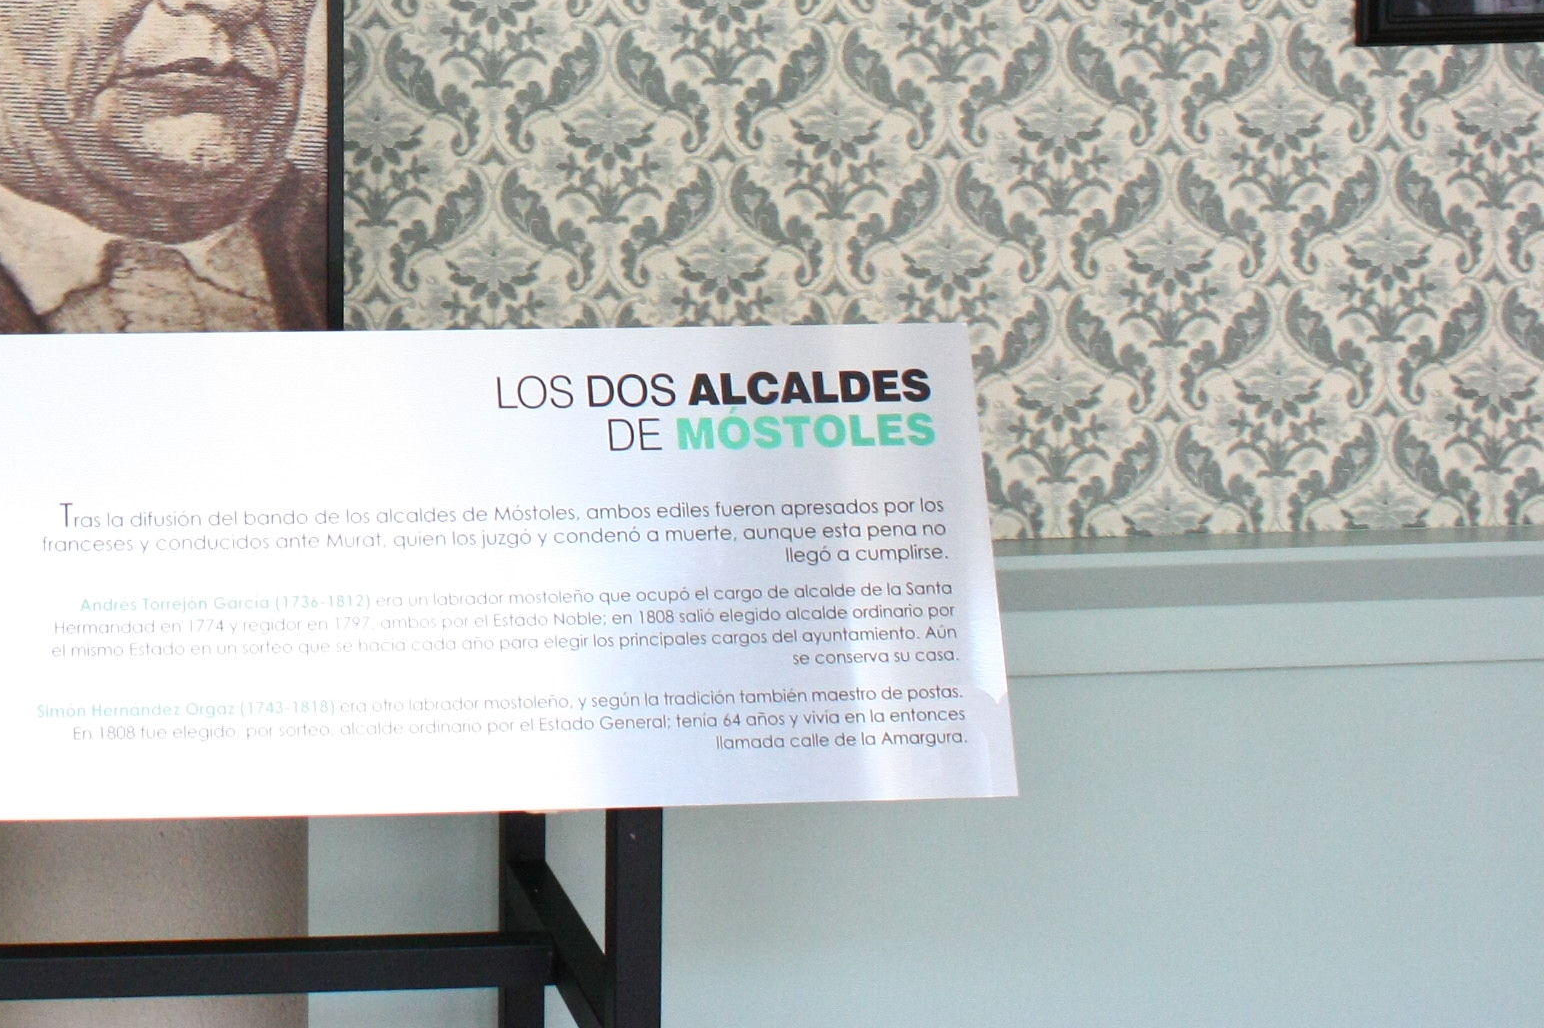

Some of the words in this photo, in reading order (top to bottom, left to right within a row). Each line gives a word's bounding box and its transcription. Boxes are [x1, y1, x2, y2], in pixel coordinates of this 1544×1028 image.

[496, 375, 573, 408] LOS
[587, 373, 675, 407] DOS
[688, 370, 930, 405] ALCALDES
[608, 418, 662, 451] DE
[677, 407, 936, 449] MÓSTOLES
[60, 503, 100, 527] Tras
[107, 513, 122, 527] la
[130, 512, 200, 526] difusión
[208, 511, 236, 525] del
[244, 510, 307, 525] bando
[315, 510, 338, 524] de
[346, 509, 369, 523] los
[376, 508, 456, 523] alcaldes
[462, 507, 487, 521] de
[494, 505, 579, 520] Móstoles,
[586, 504, 650, 519] ambos
[656, 502, 709, 518] ediles
[715, 502, 774, 516] fueron
[781, 500, 878, 518] apresados
[884, 501, 914, 516] por
[920, 498, 943, 512] los
[785, 546, 830, 565] llegó
[837, 549, 849, 561] a
[856, 544, 948, 562] cumplirse.
[792, 654, 809, 665] se
[815, 652, 888, 664] conserva
[894, 651, 909, 662] su
[915, 650, 958, 661] casa.
[716, 735, 784, 749] llamada
[790, 733, 828, 747] calle
[834, 732, 856, 746] de
[861, 732, 875, 745] la
[881, 732, 966, 747] Amargura.
